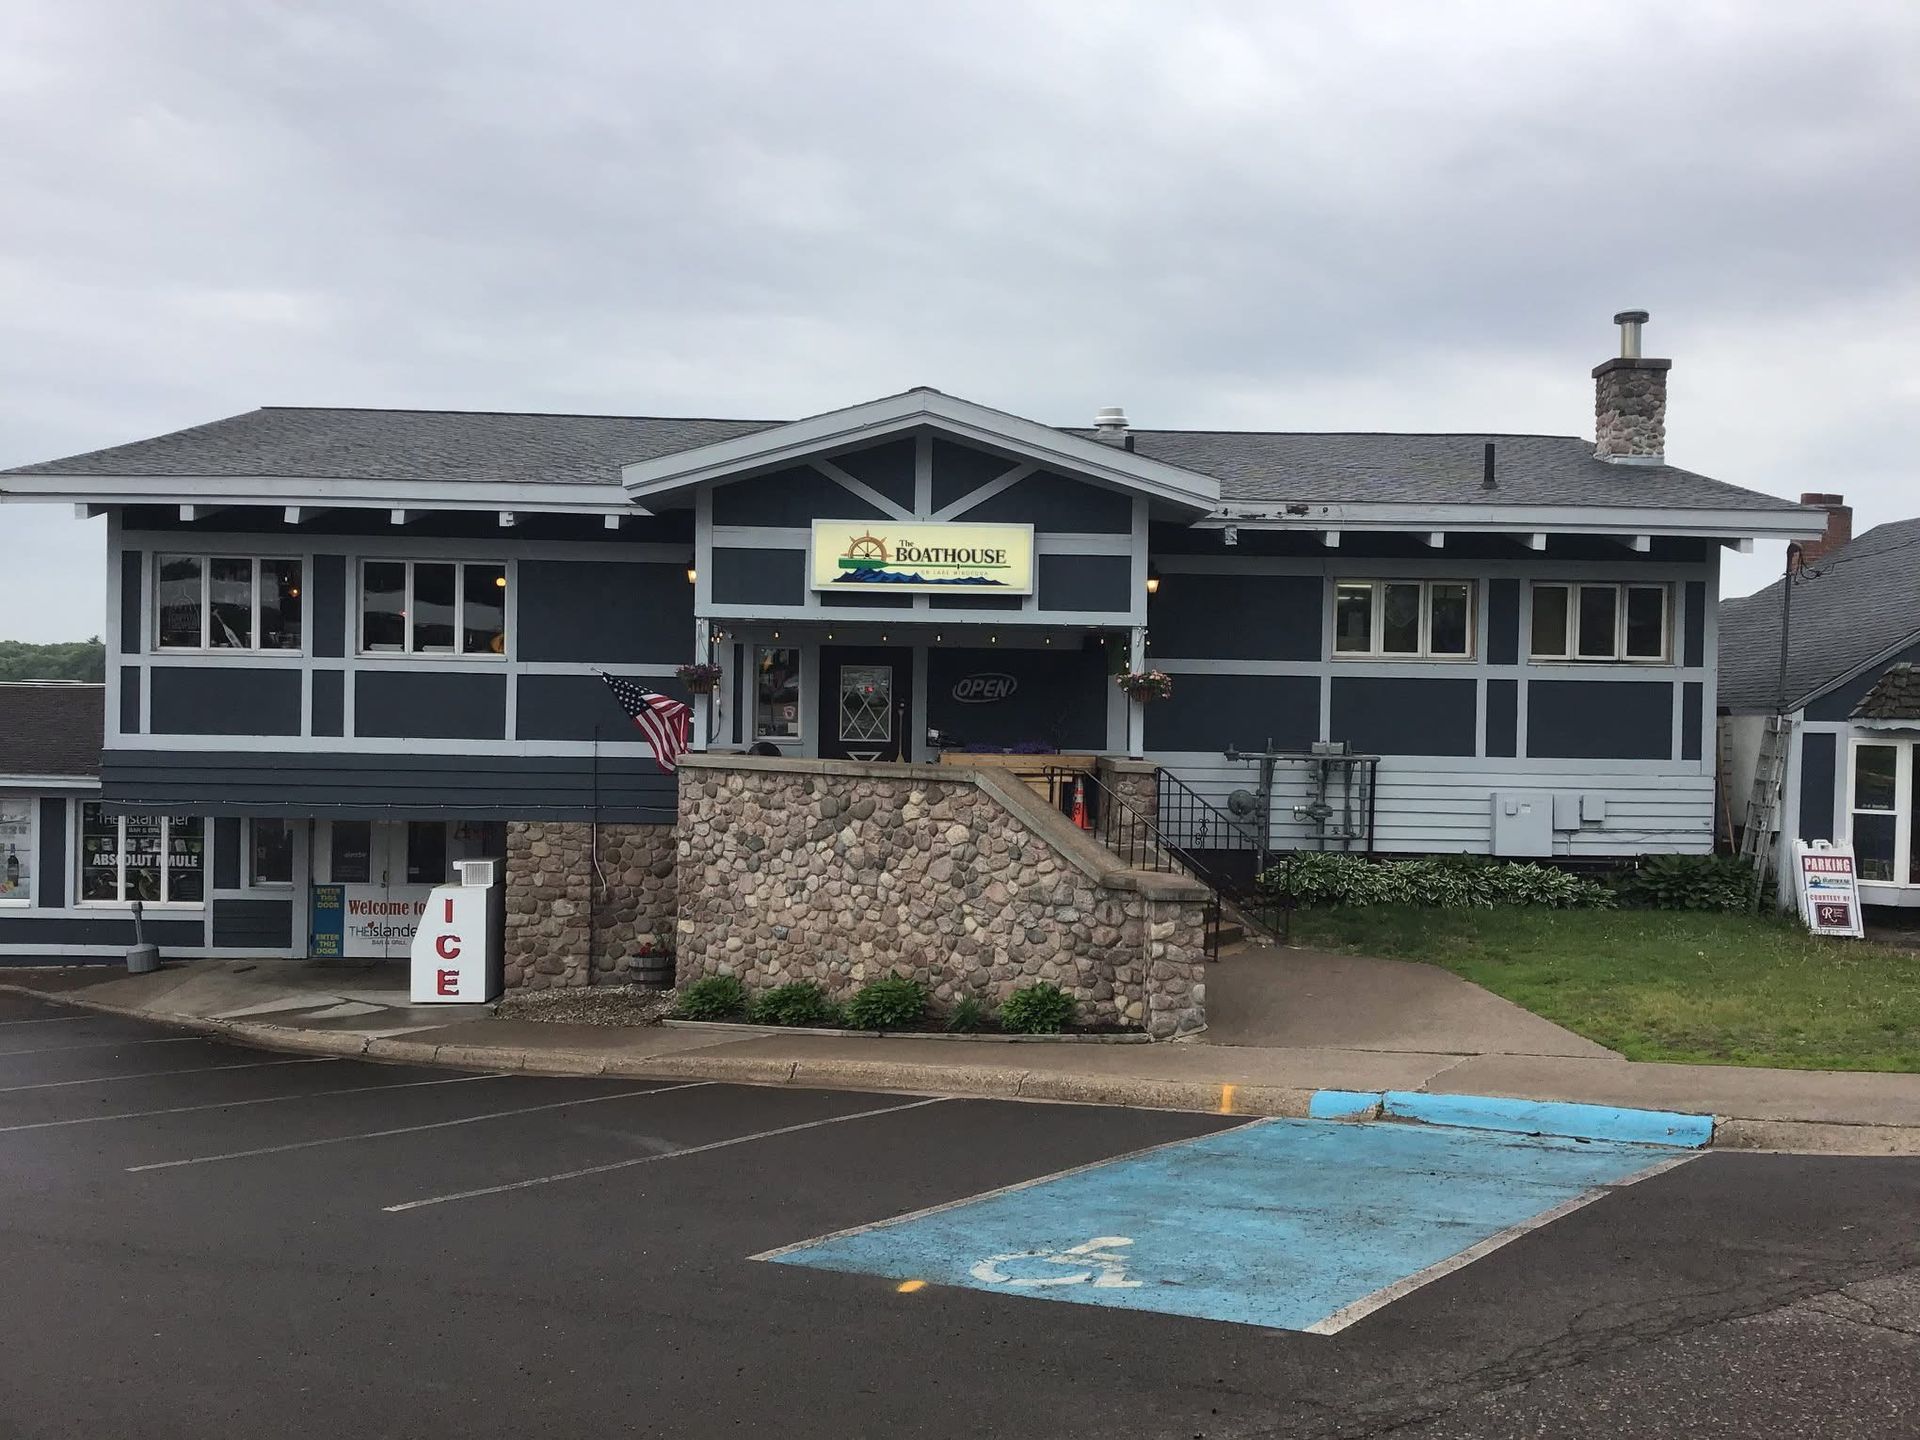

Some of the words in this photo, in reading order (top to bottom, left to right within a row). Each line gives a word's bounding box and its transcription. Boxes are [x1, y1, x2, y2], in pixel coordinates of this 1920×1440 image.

[896, 547, 1007, 564] BOATHOUSE
[957, 679, 1010, 697] OPEN
[1805, 858, 1851, 872] PARKING
[348, 900, 409, 915] Welcome
[413, 901, 427, 916] to
[436, 898, 461, 996] ICE
